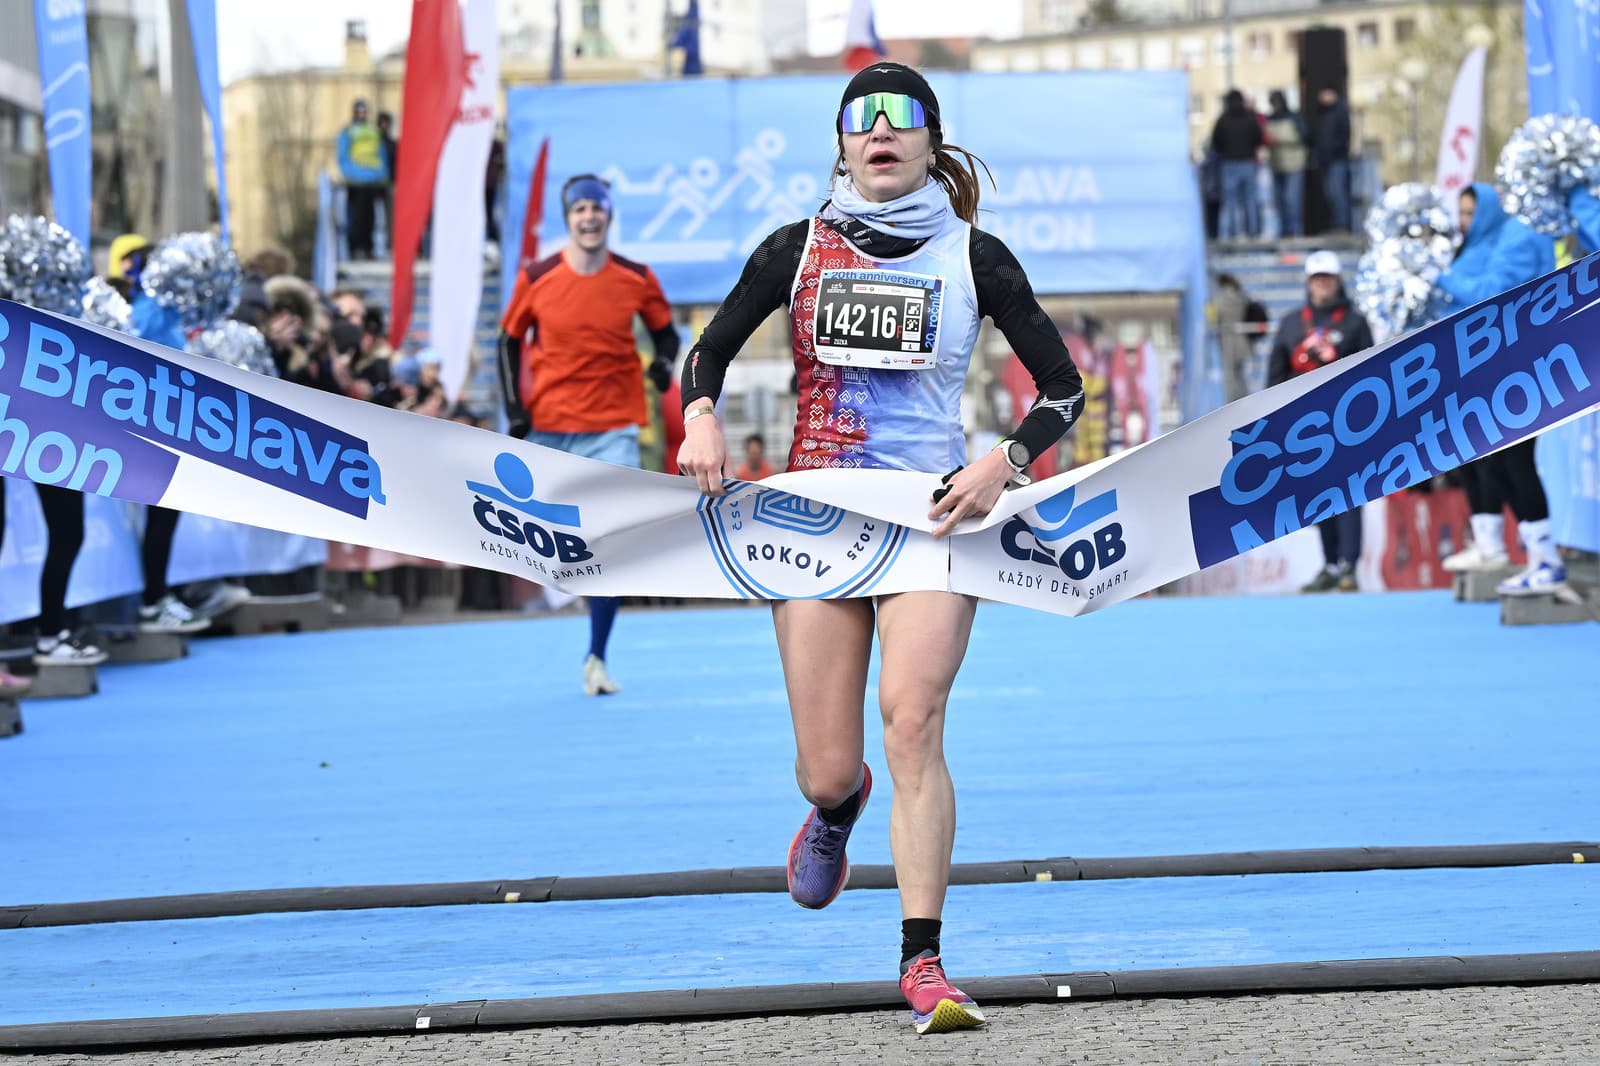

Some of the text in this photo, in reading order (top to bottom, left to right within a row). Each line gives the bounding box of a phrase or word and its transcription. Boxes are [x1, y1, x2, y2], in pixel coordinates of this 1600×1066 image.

[831, 271, 929, 288] 20th anniversary
[823, 302, 898, 339] 14216
[927, 291, 942, 328] ročník
[20, 321, 387, 506] Bratislava
[1219, 342, 1441, 506] ČSOB
[1229, 342, 1592, 556] Marathon
[472, 493, 594, 564] ČSOB
[847, 522, 876, 561] 2025
[480, 540, 603, 580] KAŽDÝ DEŇ SMART
[746, 543, 832, 578] ROKOV
[998, 568, 1043, 590] KAŽDÝ
[1088, 569, 1129, 599] SMART
